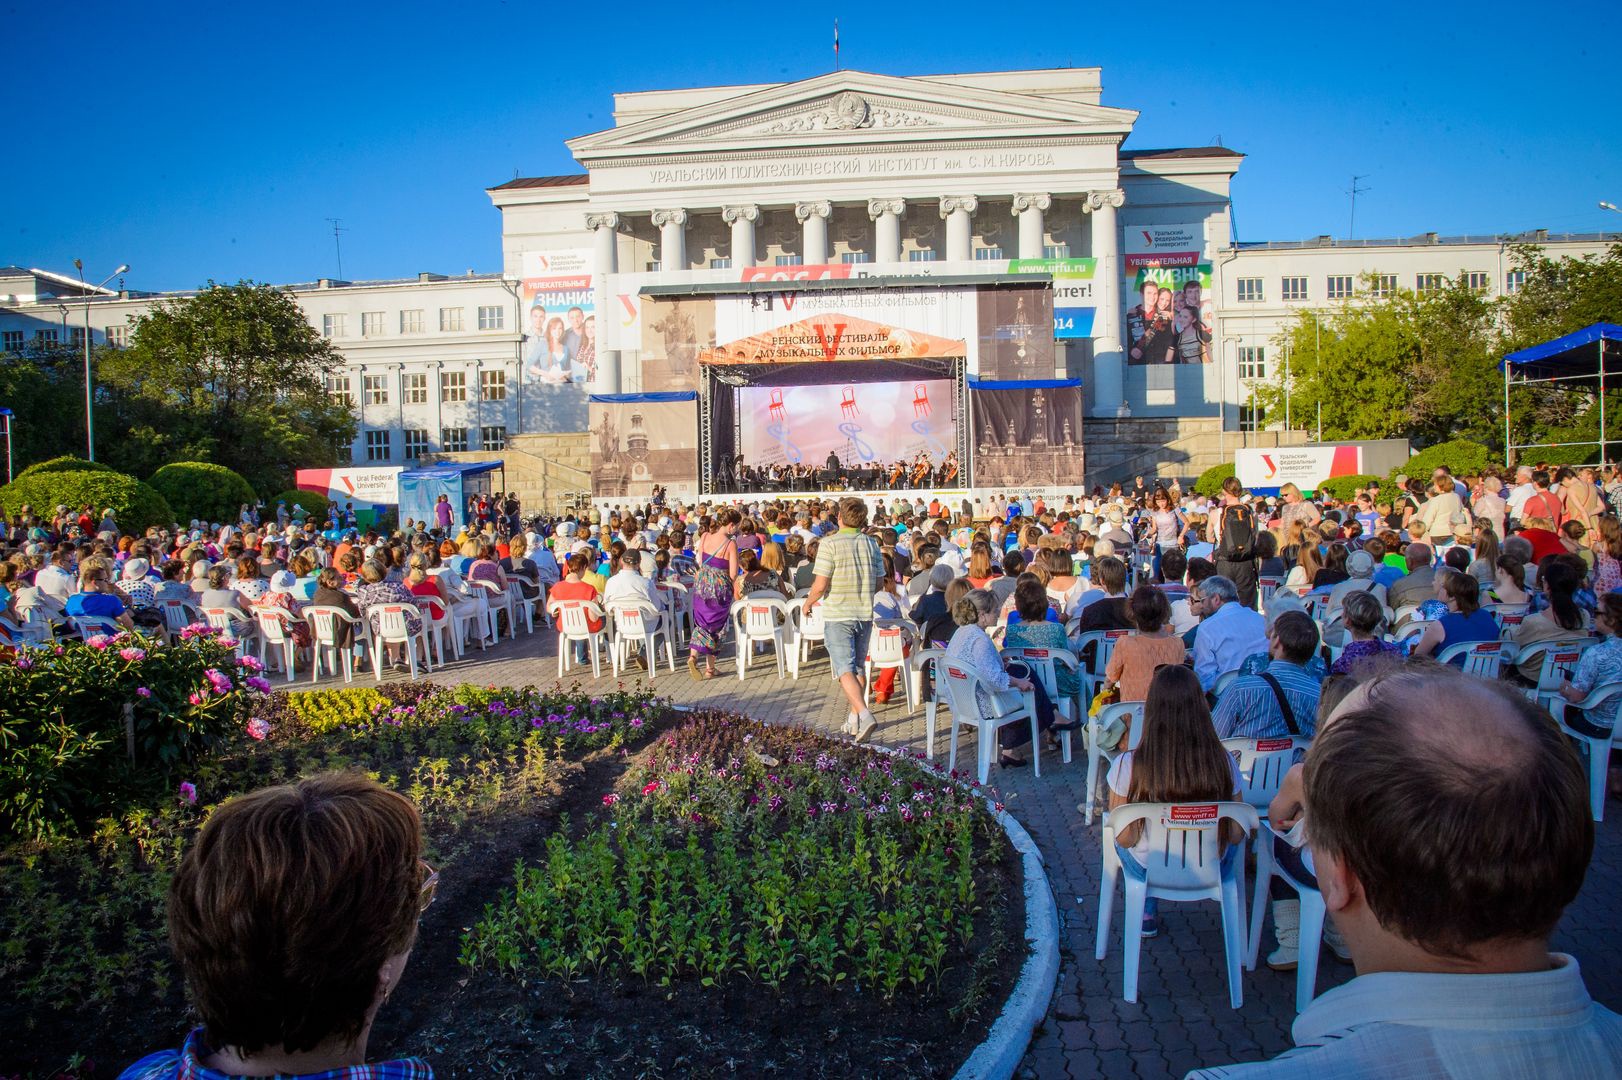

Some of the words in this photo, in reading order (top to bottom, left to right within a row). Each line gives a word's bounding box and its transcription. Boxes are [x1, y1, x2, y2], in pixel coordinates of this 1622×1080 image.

[650, 165, 727, 183] УРАЛЬСКИЙ
[868, 157, 938, 172] ИНСТИТУТ
[1154, 229, 1184, 237] Уральский
[1154, 235, 1193, 243] федеральный
[1130, 257, 1192, 266] УВЛЕКАТЕЛЬНАЯ
[1018, 263, 1086, 273] www.urfu.ru
[1143, 268, 1204, 283] ЖИЗНЬ
[528, 280, 586, 289] УВЛЕКАТЕЛЬНЫЕ
[536, 292, 594, 306] ЗНАНИЯ
[885, 296, 937, 307] ФИЛЬМОВ
[771, 334, 821, 346] ВЕНСКИЙ
[825, 333, 889, 344] ФЕСТИВАЛЬ
[760, 347, 845, 358] МУЗЫКАЛЬНЫХ
